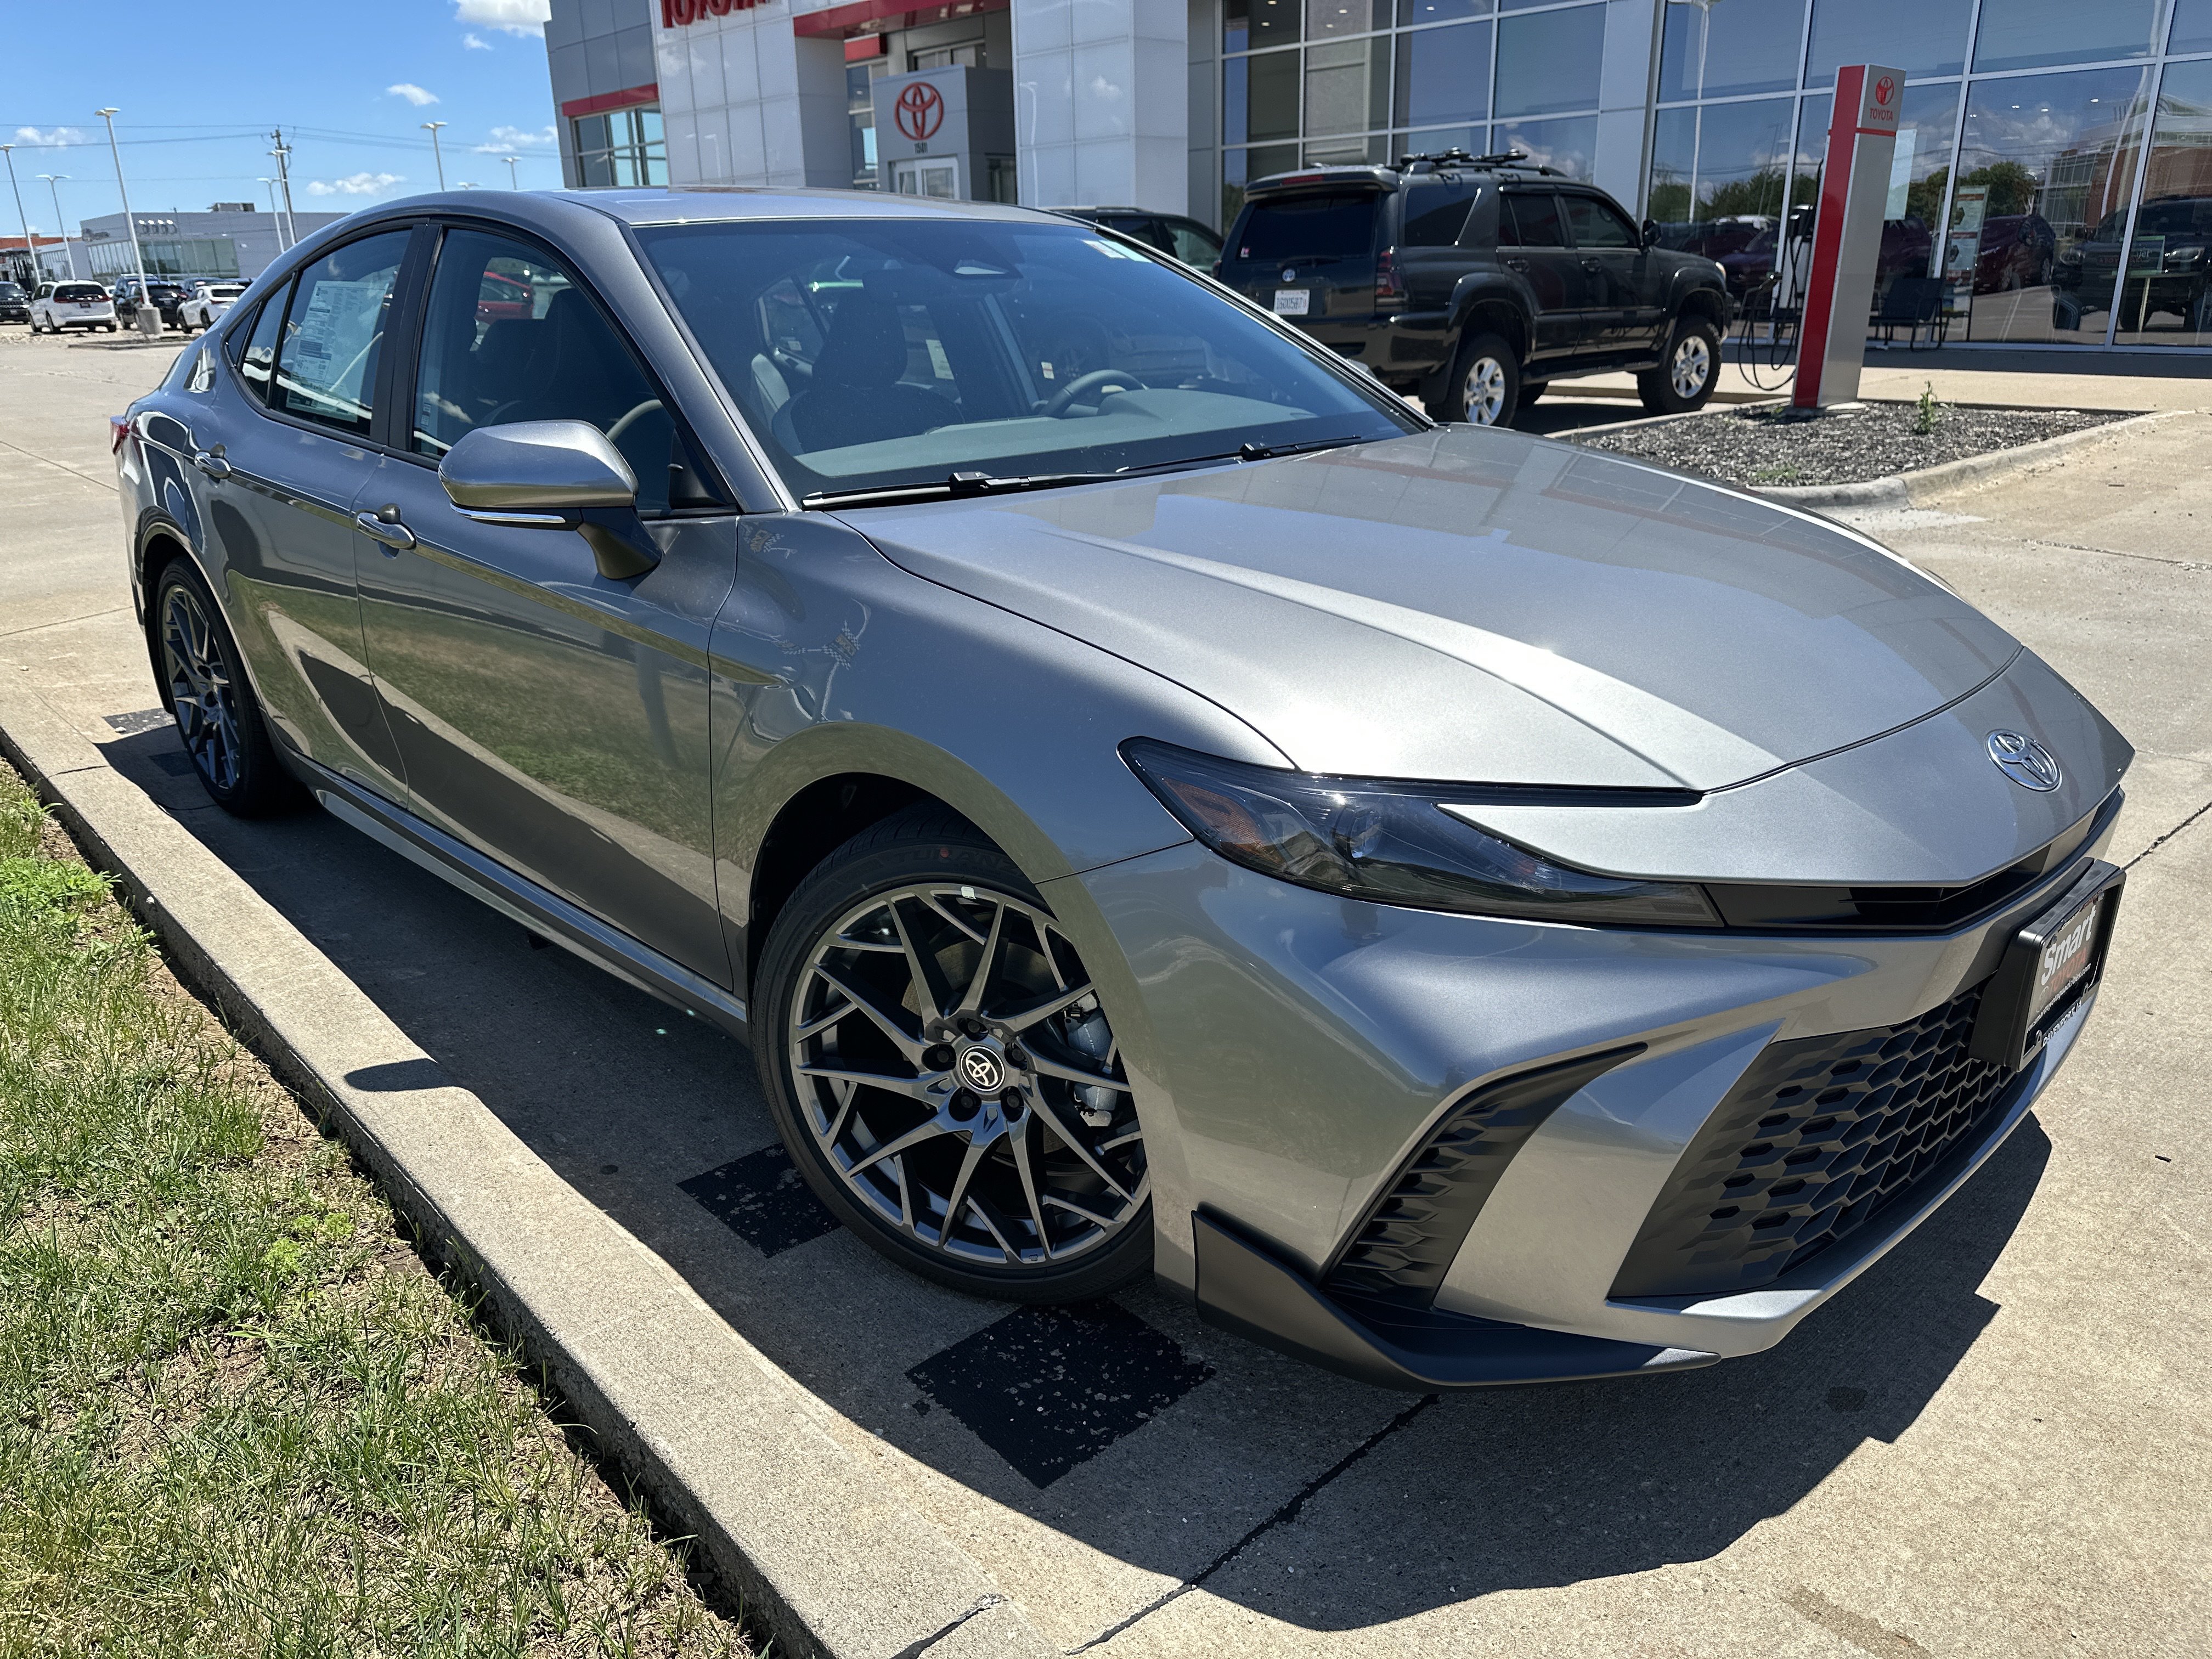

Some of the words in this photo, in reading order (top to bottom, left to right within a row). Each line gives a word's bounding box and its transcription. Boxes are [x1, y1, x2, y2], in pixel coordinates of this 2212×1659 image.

[1870, 108, 1893, 122] TOYOTA
[2041, 905, 2096, 985] Smart
[2049, 947, 2087, 996] TOYOTA
[2076, 1000, 2081, 1011] IA
